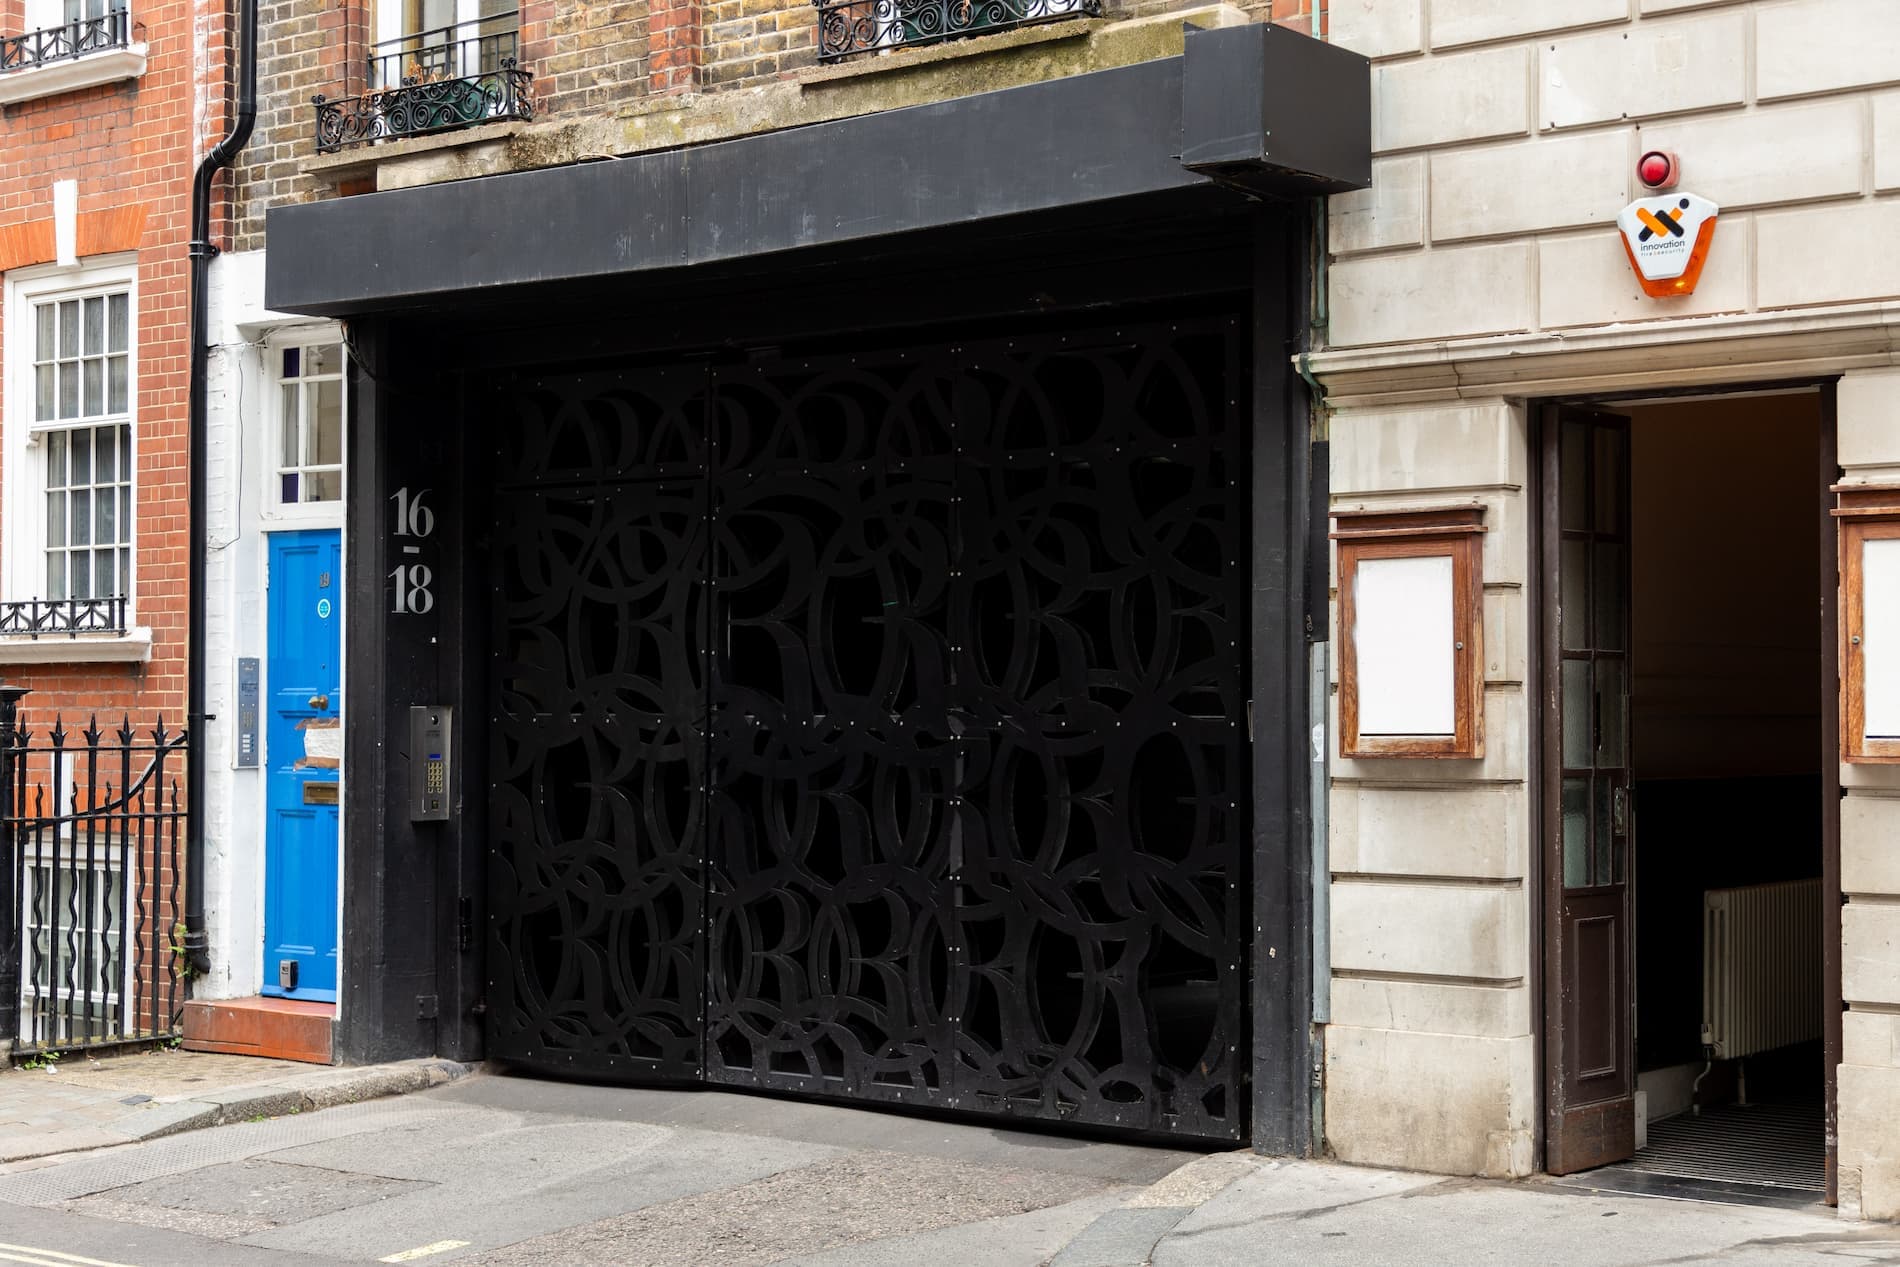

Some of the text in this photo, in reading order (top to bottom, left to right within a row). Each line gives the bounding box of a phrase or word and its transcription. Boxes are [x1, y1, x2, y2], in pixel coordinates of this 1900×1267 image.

[1640, 240, 1685, 251] innovation
[389, 487, 434, 538] 16
[388, 564, 434, 614] 18
